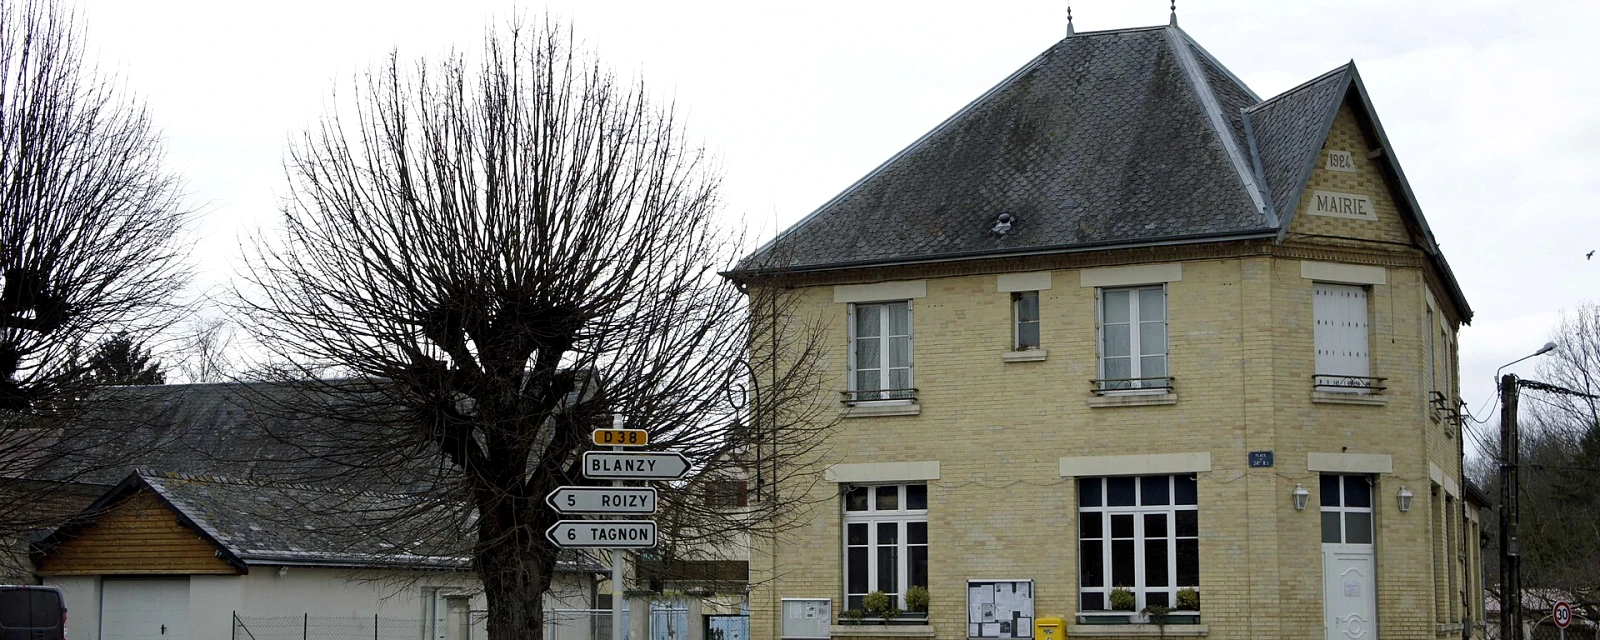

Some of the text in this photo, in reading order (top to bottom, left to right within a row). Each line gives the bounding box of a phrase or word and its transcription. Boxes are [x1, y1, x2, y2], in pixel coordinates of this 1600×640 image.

[1330, 153, 1351, 169] 1924
[1316, 194, 1367, 216] MAIRIE
[604, 431, 637, 444] D 38
[592, 459, 656, 472] BLANZY
[567, 494, 648, 507] 5 ROIZY
[567, 528, 648, 541] 6 TAGNON
[1557, 608, 1568, 620] 30
